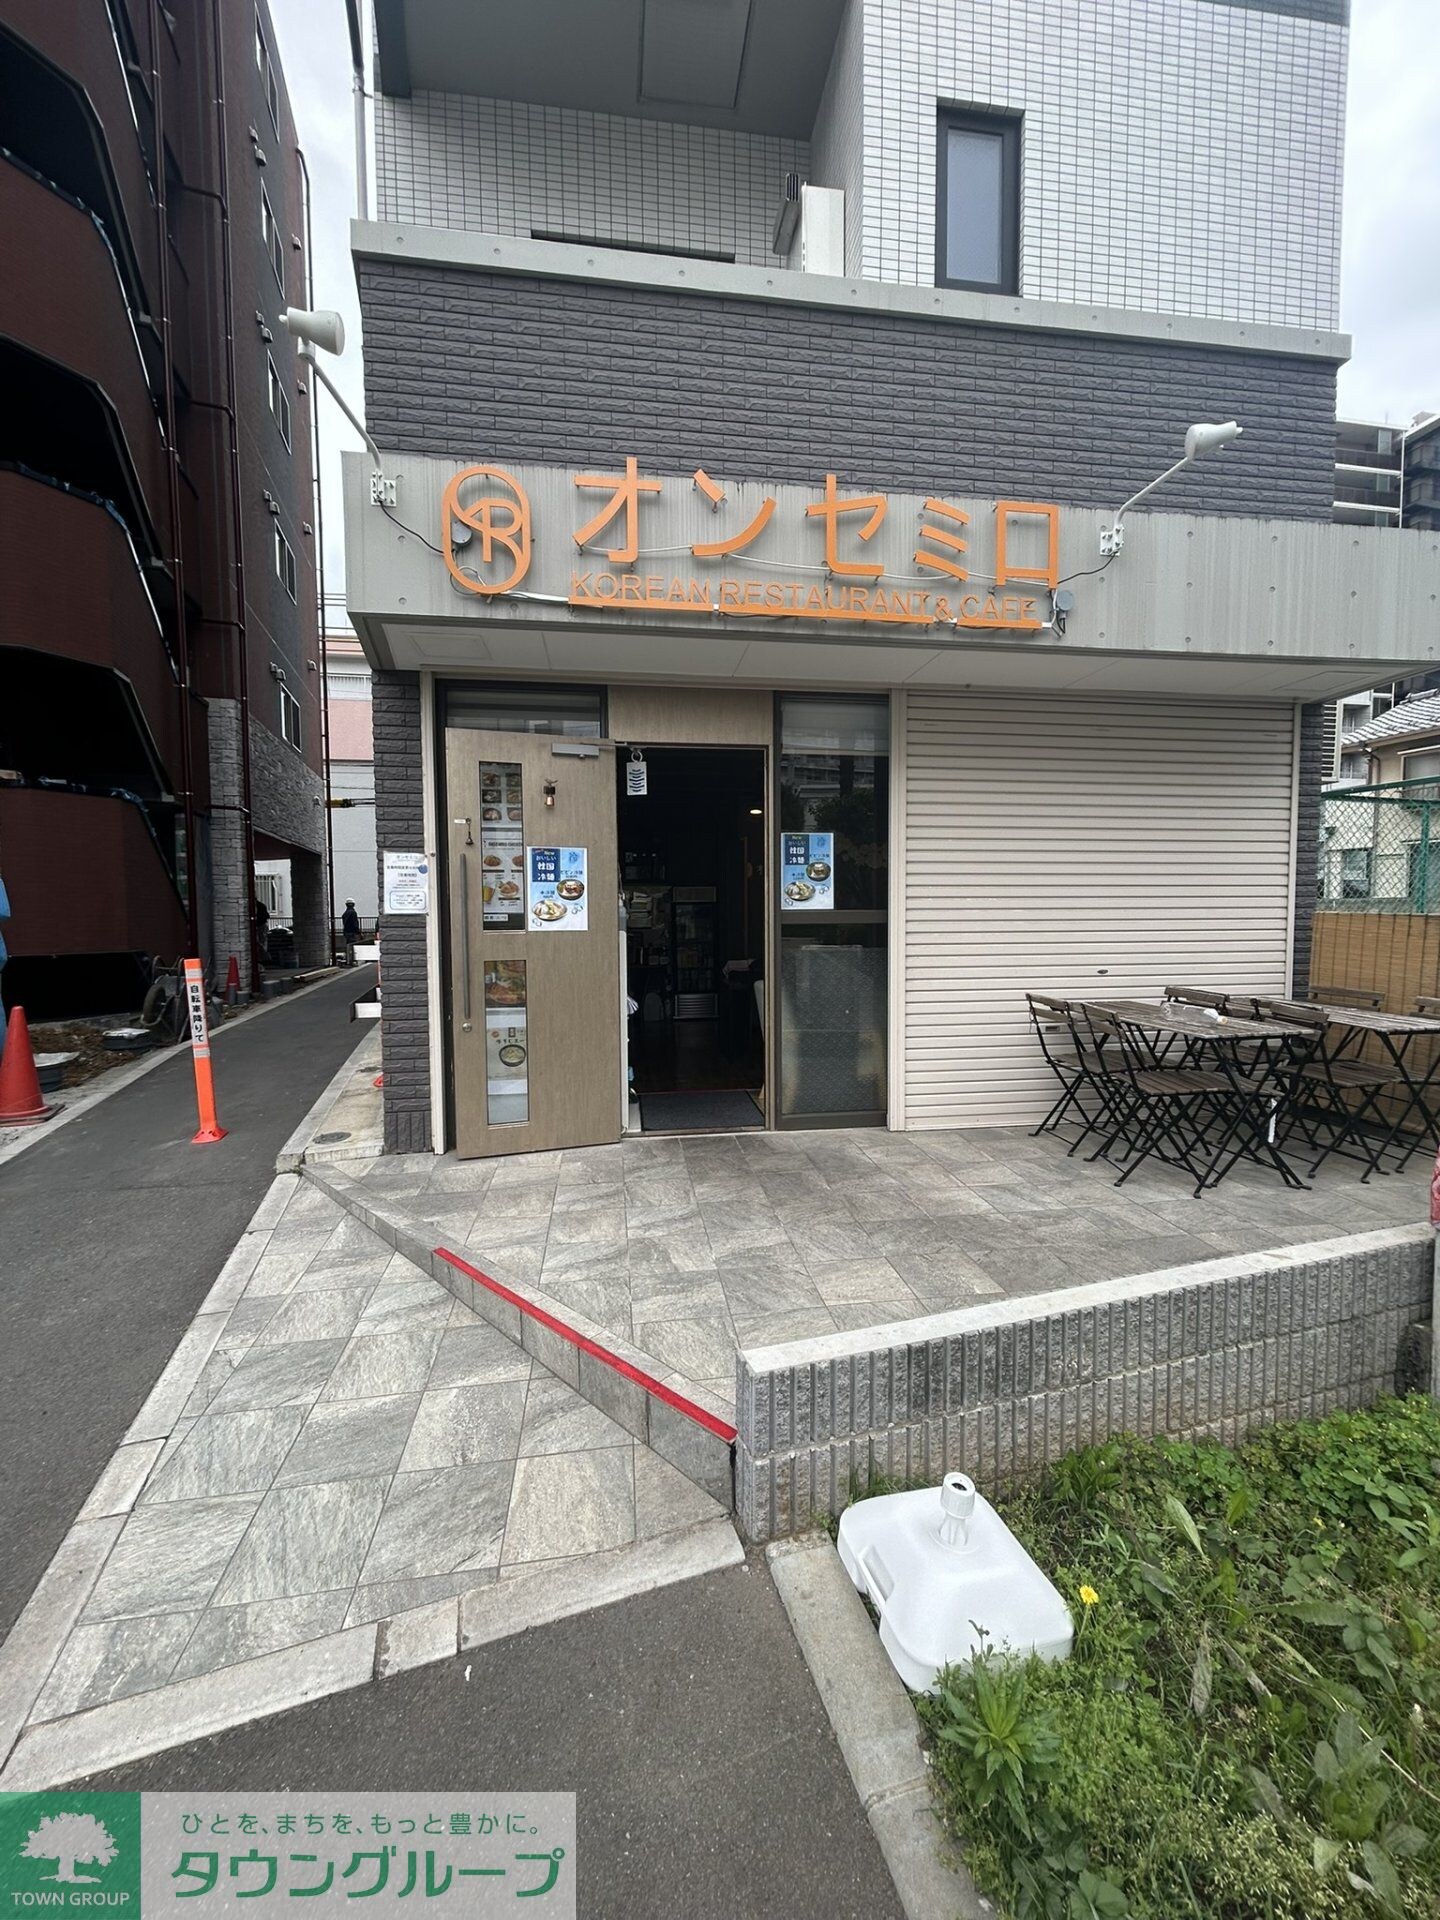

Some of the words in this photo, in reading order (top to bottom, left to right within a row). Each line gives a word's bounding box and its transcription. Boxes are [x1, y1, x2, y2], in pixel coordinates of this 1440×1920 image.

[572, 457, 1058, 588] オンセミロ
[571, 570, 711, 604] KOREAN
[720, 577, 933, 618] RESTAURANT
[934, 596, 954, 621] &
[959, 593, 1038, 623] CAFE
[190, 984, 204, 1042] 自転車降りて
